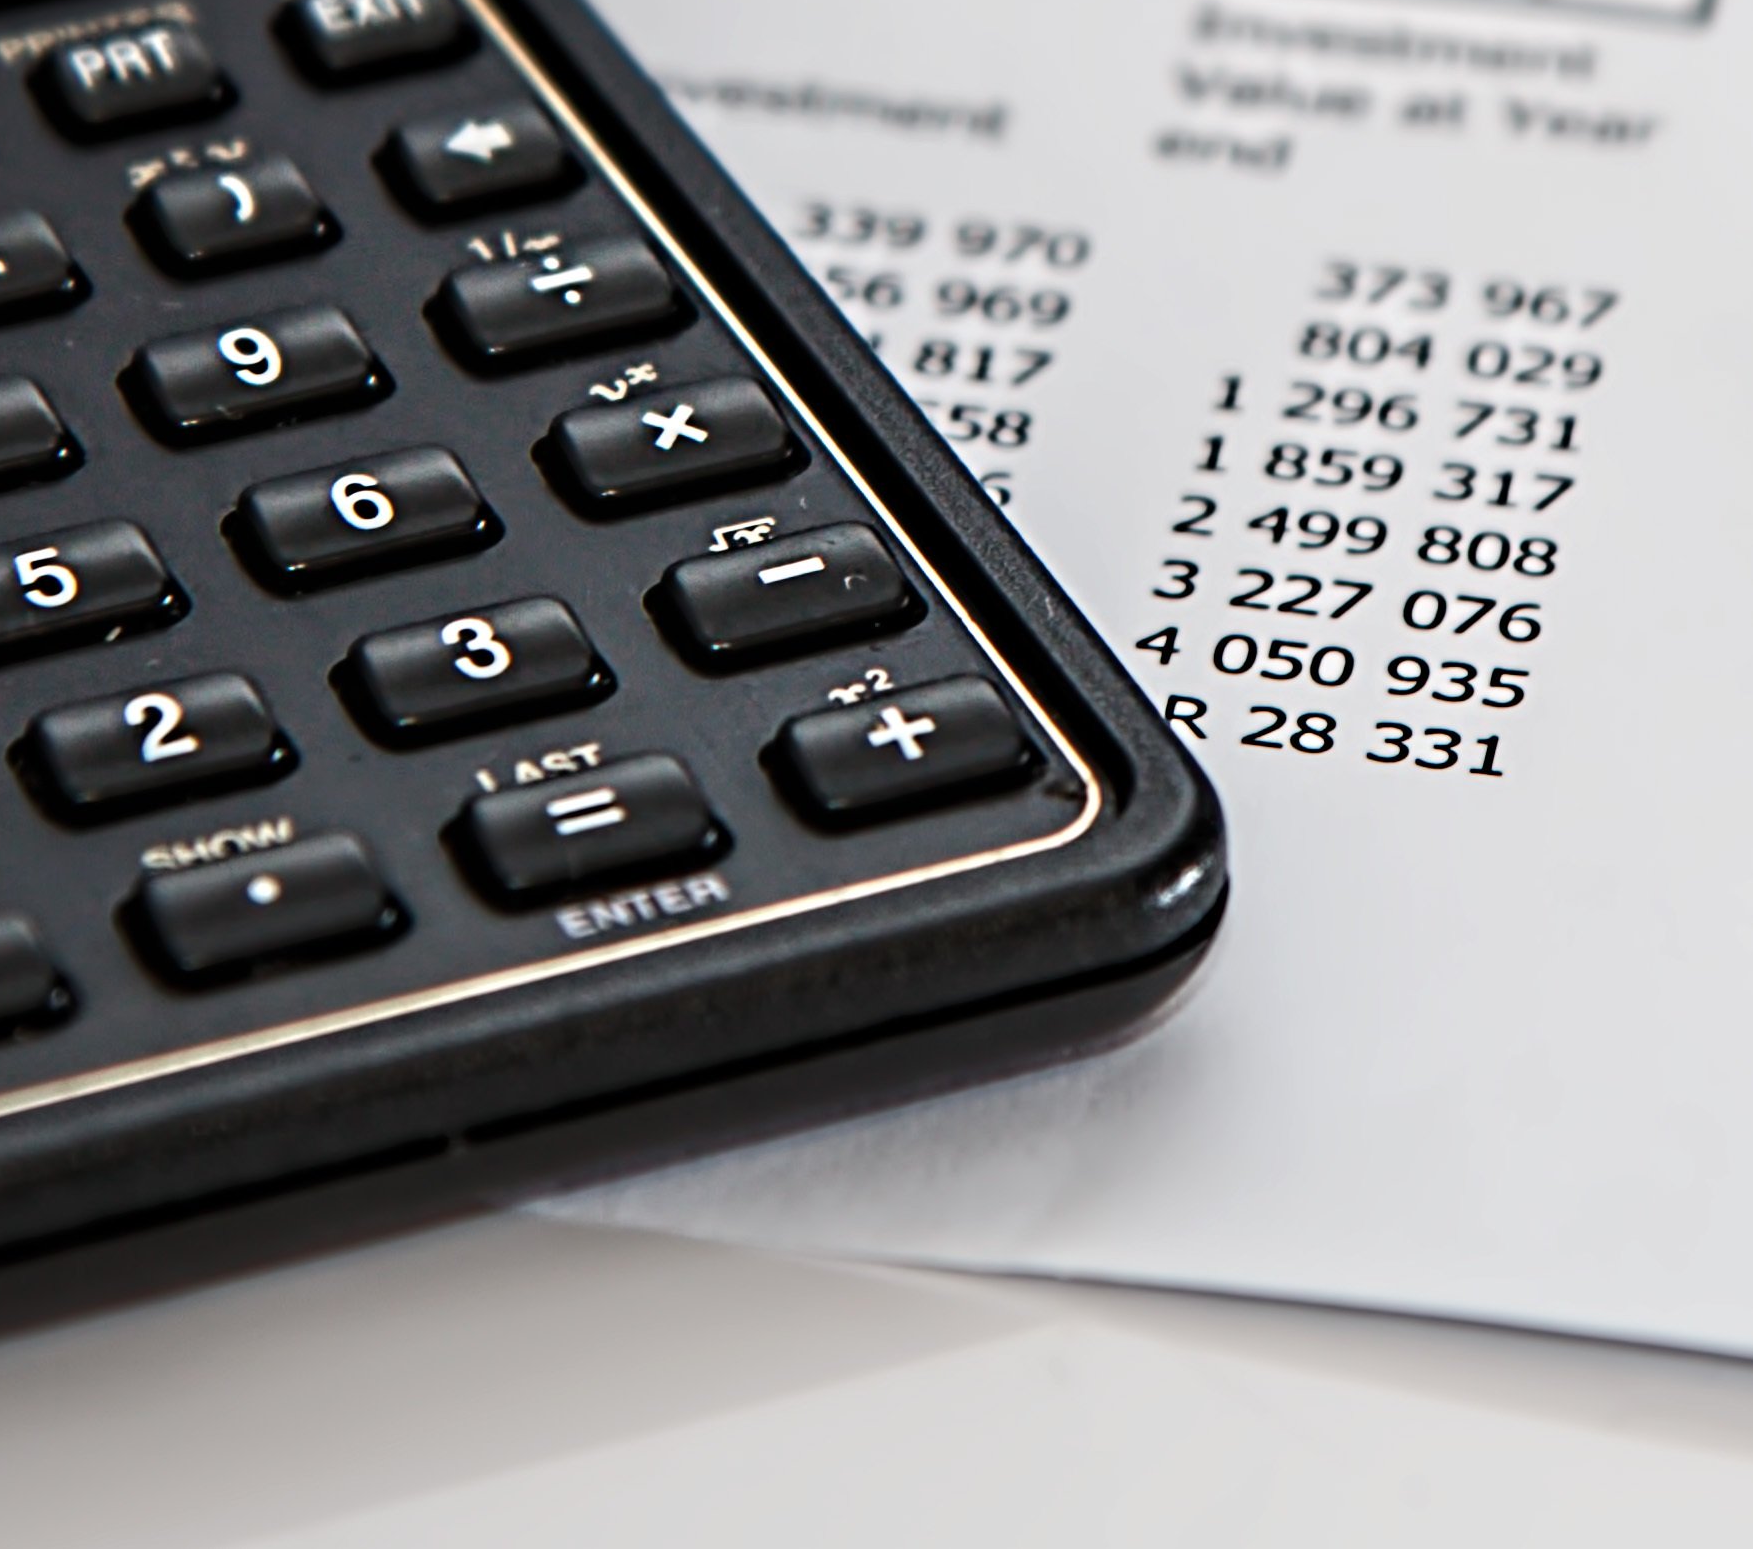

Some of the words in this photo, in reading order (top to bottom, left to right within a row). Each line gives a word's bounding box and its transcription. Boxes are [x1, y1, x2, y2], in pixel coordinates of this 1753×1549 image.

[69, 30, 176, 91] PRT
[1189, 0, 1597, 81] Investment
[1175, 66, 1374, 118] Value
[1395, 90, 1470, 132] at
[1498, 99, 1664, 146] Year
[1151, 123, 1297, 177] end
[218, 174, 254, 223] )
[797, 203, 925, 249] 339
[955, 219, 1091, 268] 970
[936, 280, 1070, 325] 969
[1316, 262, 1450, 307] 373
[1481, 282, 1618, 331] 967
[219, 326, 283, 387] 9
[914, 338, 1053, 385] 817
[1299, 323, 1435, 370] 804
[1466, 341, 1603, 389] 029
[1214, 376, 1244, 412] 1
[1281, 383, 1419, 432] 296
[1452, 403, 1580, 453] 731
[331, 471, 395, 532] 6
[1196, 435, 1225, 473] 1
[1264, 443, 1403, 492] 859
[1435, 463, 1575, 513] 317
[1172, 496, 1217, 537] 2
[1247, 506, 1388, 554] 499
[1417, 528, 1560, 578] 808
[14, 548, 78, 609] 5
[1153, 561, 1200, 599] 3
[1228, 571, 1374, 621] 227
[1402, 590, 1544, 643] 076
[440, 616, 511, 680] 3
[1135, 628, 1181, 665] 4
[1211, 634, 1355, 689] 050
[1386, 655, 1531, 709] 935
[123, 691, 200, 765] 2
[1165, 696, 1210, 740] R
[1241, 706, 1338, 754] 28
[1366, 721, 1505, 778] 331
[555, 872, 731, 939] ENTER
